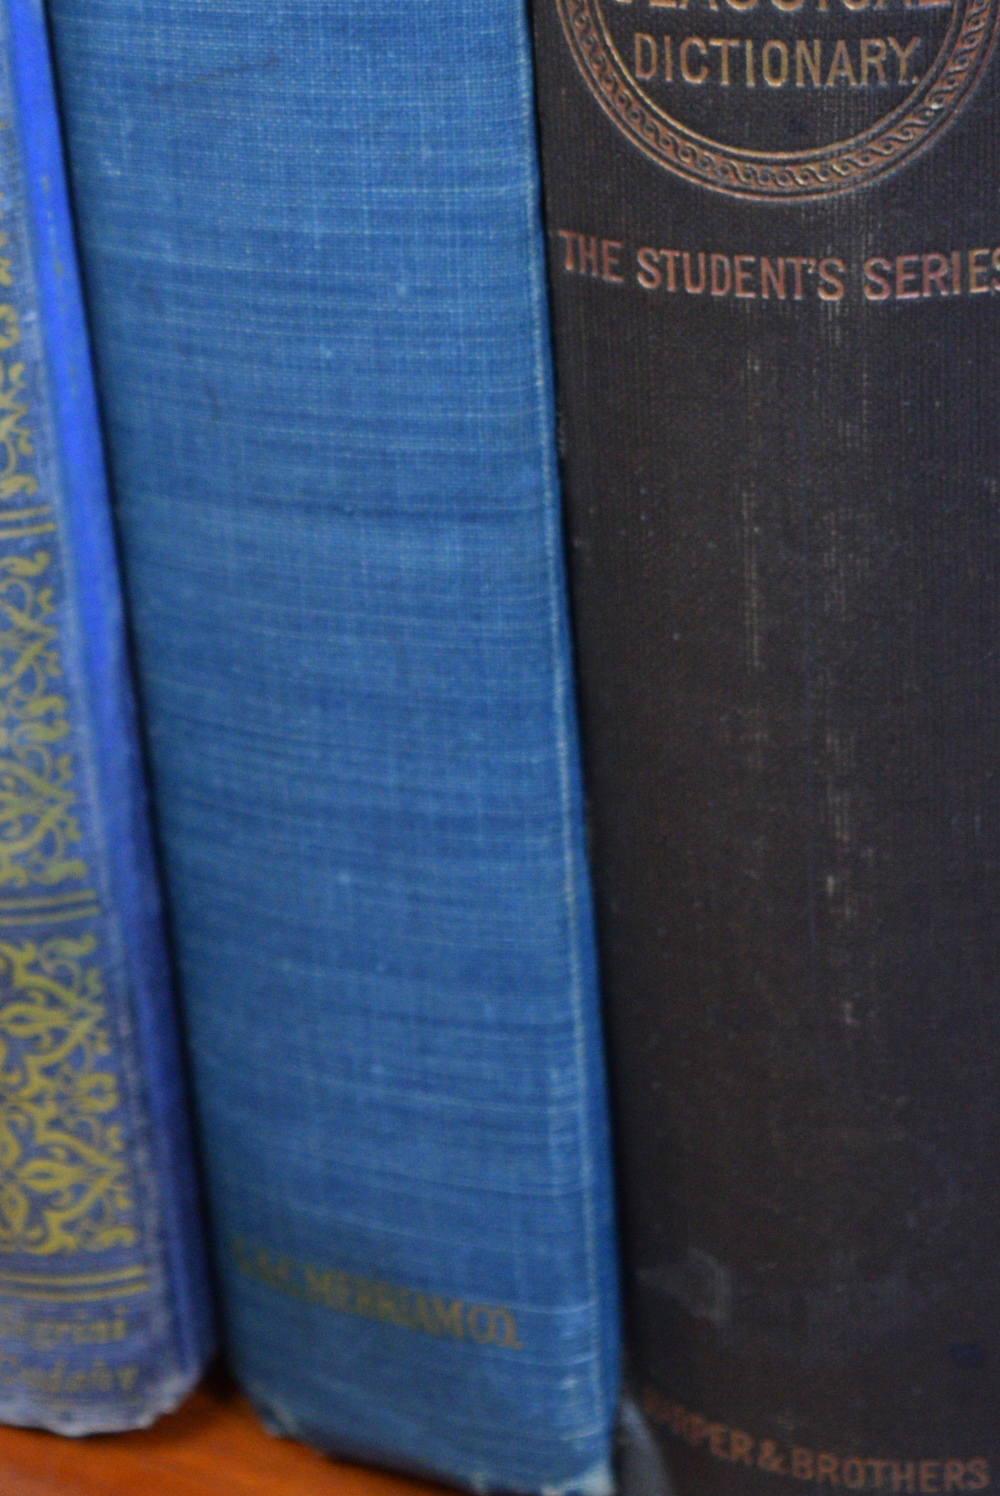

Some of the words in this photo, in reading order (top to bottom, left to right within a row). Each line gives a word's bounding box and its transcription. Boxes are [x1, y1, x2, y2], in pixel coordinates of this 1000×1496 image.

[557, 228, 625, 285] THE
[636, 248, 846, 301] STUDENT'S
[790, 1445, 993, 1494] BROTHERS
